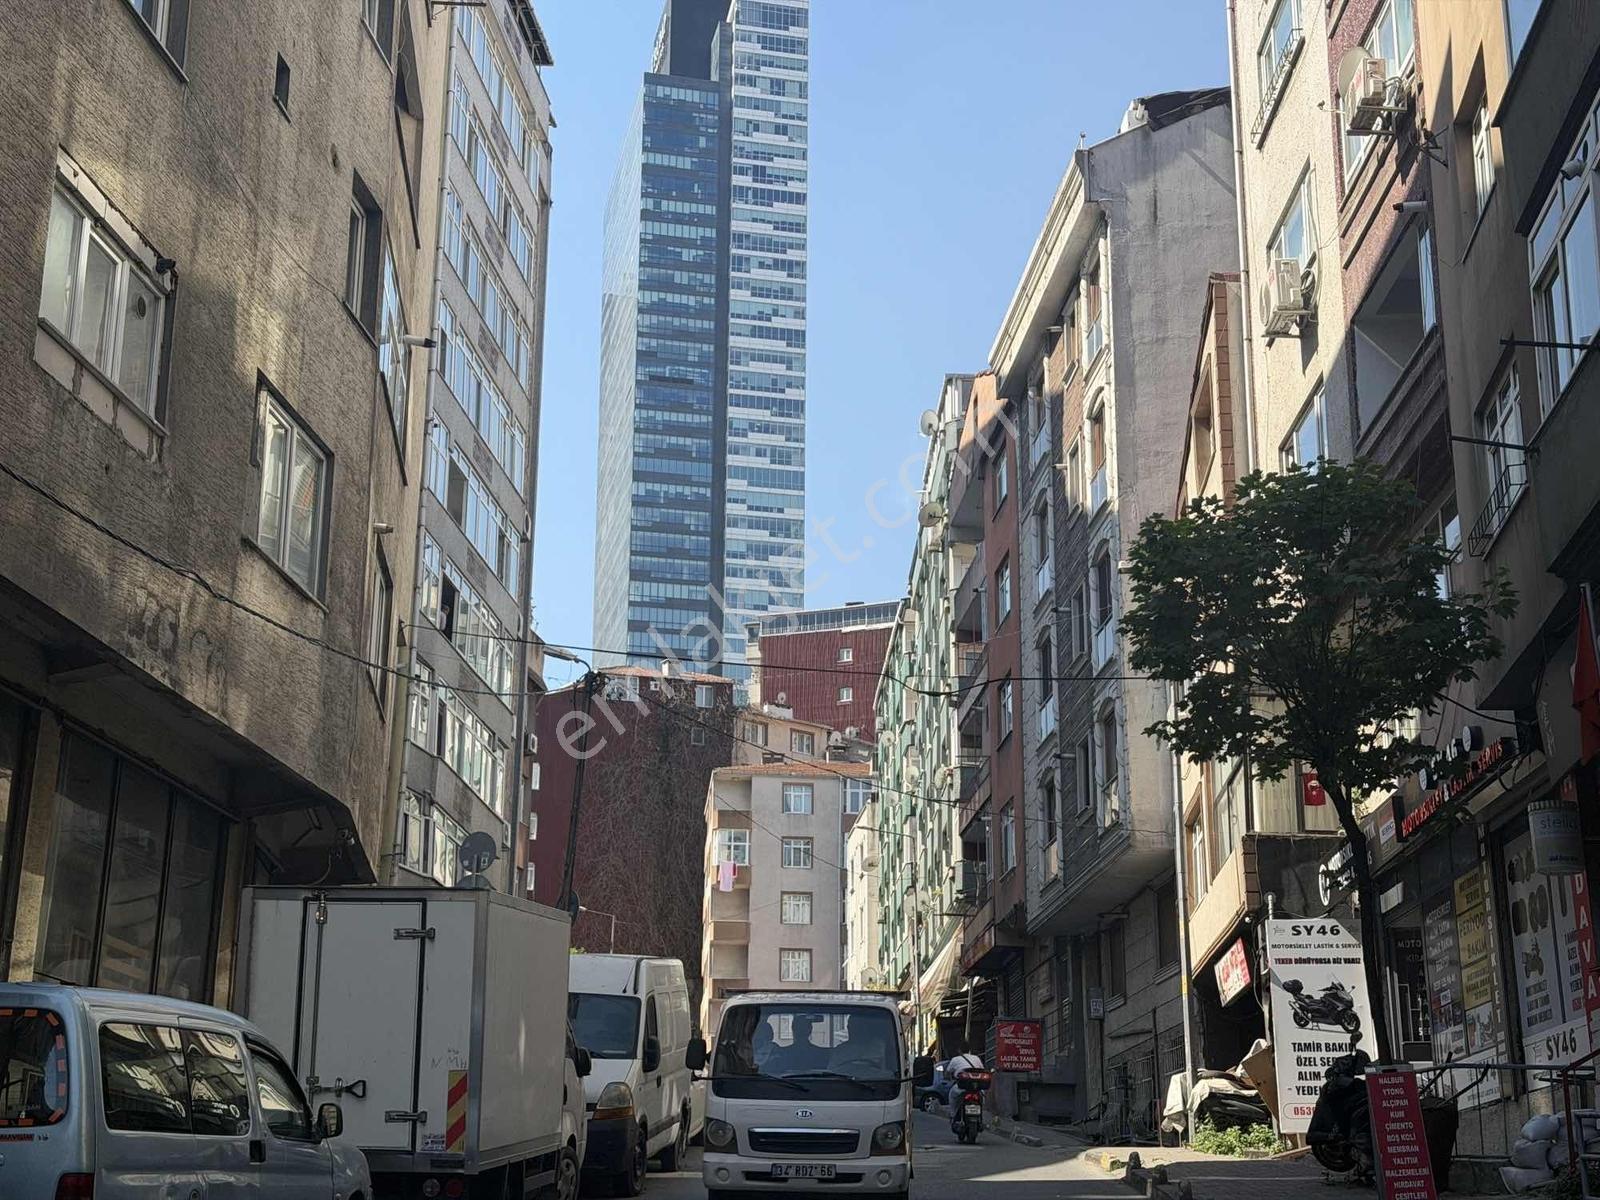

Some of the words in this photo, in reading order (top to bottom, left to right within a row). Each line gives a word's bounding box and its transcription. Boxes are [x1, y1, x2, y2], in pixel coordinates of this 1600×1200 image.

[1291, 924, 1341, 937] SY46
[1291, 1040, 1322, 1053] TAMİR
[1545, 1027, 1577, 1061] SY46
[1296, 1054, 1318, 1067] ÖZEL
[1378, 1076, 1404, 1085] NALBUR
[1382, 1087, 1405, 1097] YTONG
[1382, 1099, 1409, 1110] ALÇIPAN
[1389, 1110, 1405, 1119] KUM
[1384, 1121, 1414, 1132] ÇİMENTO
[1387, 1144, 1420, 1154] MEMBRAN
[1392, 1155, 1418, 1165] YALITIM
[1393, 1179, 1425, 1189] HIRDAVAT
